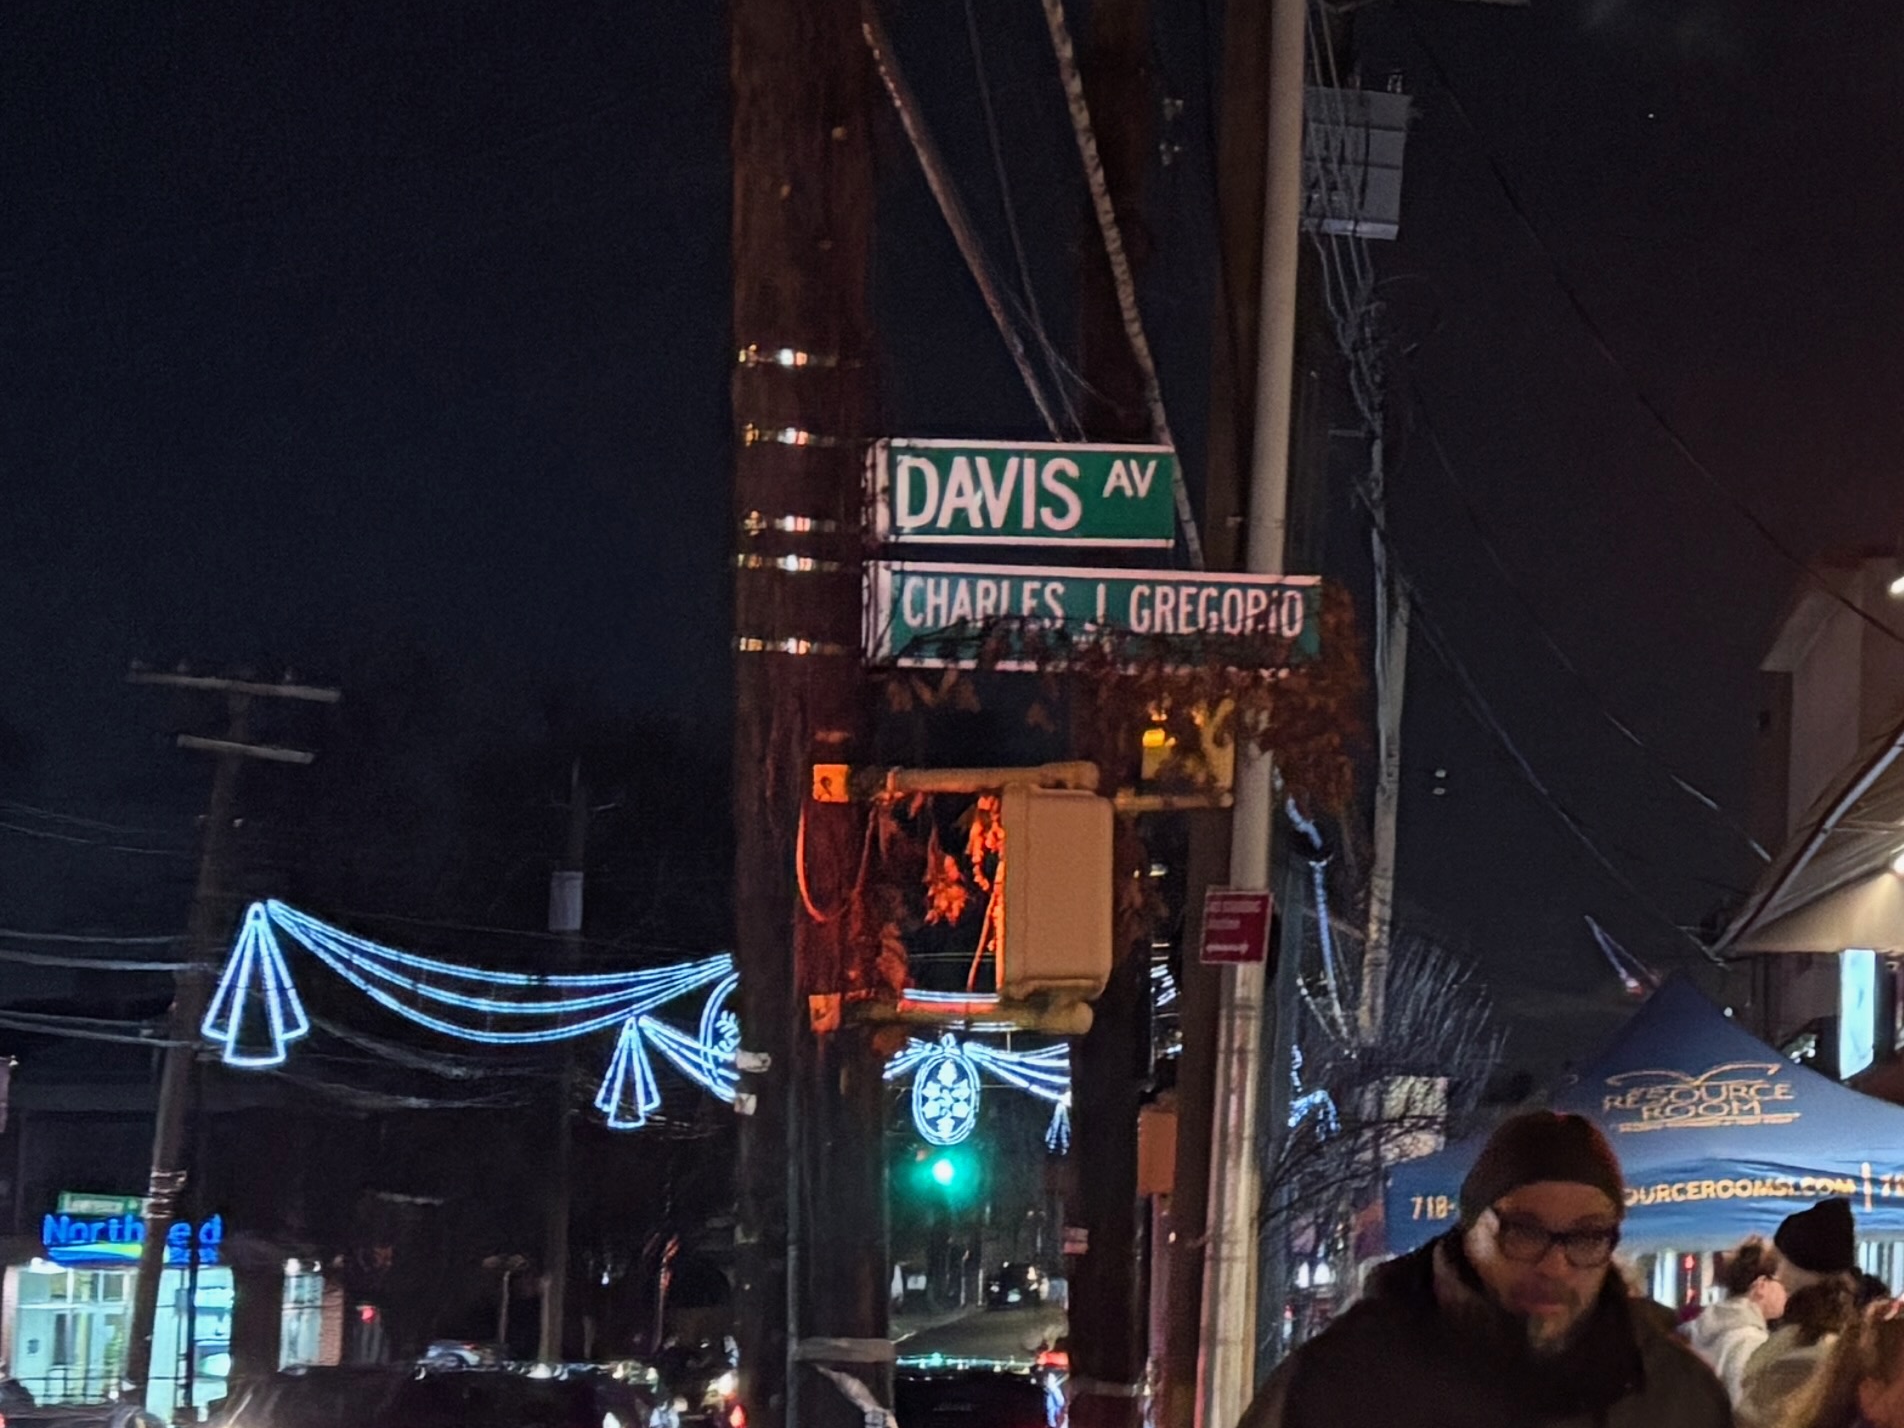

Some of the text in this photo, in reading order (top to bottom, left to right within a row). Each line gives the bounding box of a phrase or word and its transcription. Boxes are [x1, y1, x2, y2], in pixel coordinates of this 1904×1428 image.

[895, 455, 1157, 531] DAVIS AV
[903, 577, 1065, 629] CHARLES
[1130, 584, 1304, 637] GREGORIO
[1602, 1082, 1795, 1112] RESOURCE
[1642, 1099, 1762, 1121] ROOM
[1624, 1176, 1856, 1207] OURCEROOMSI.COM
[43, 1214, 222, 1245] Northed
